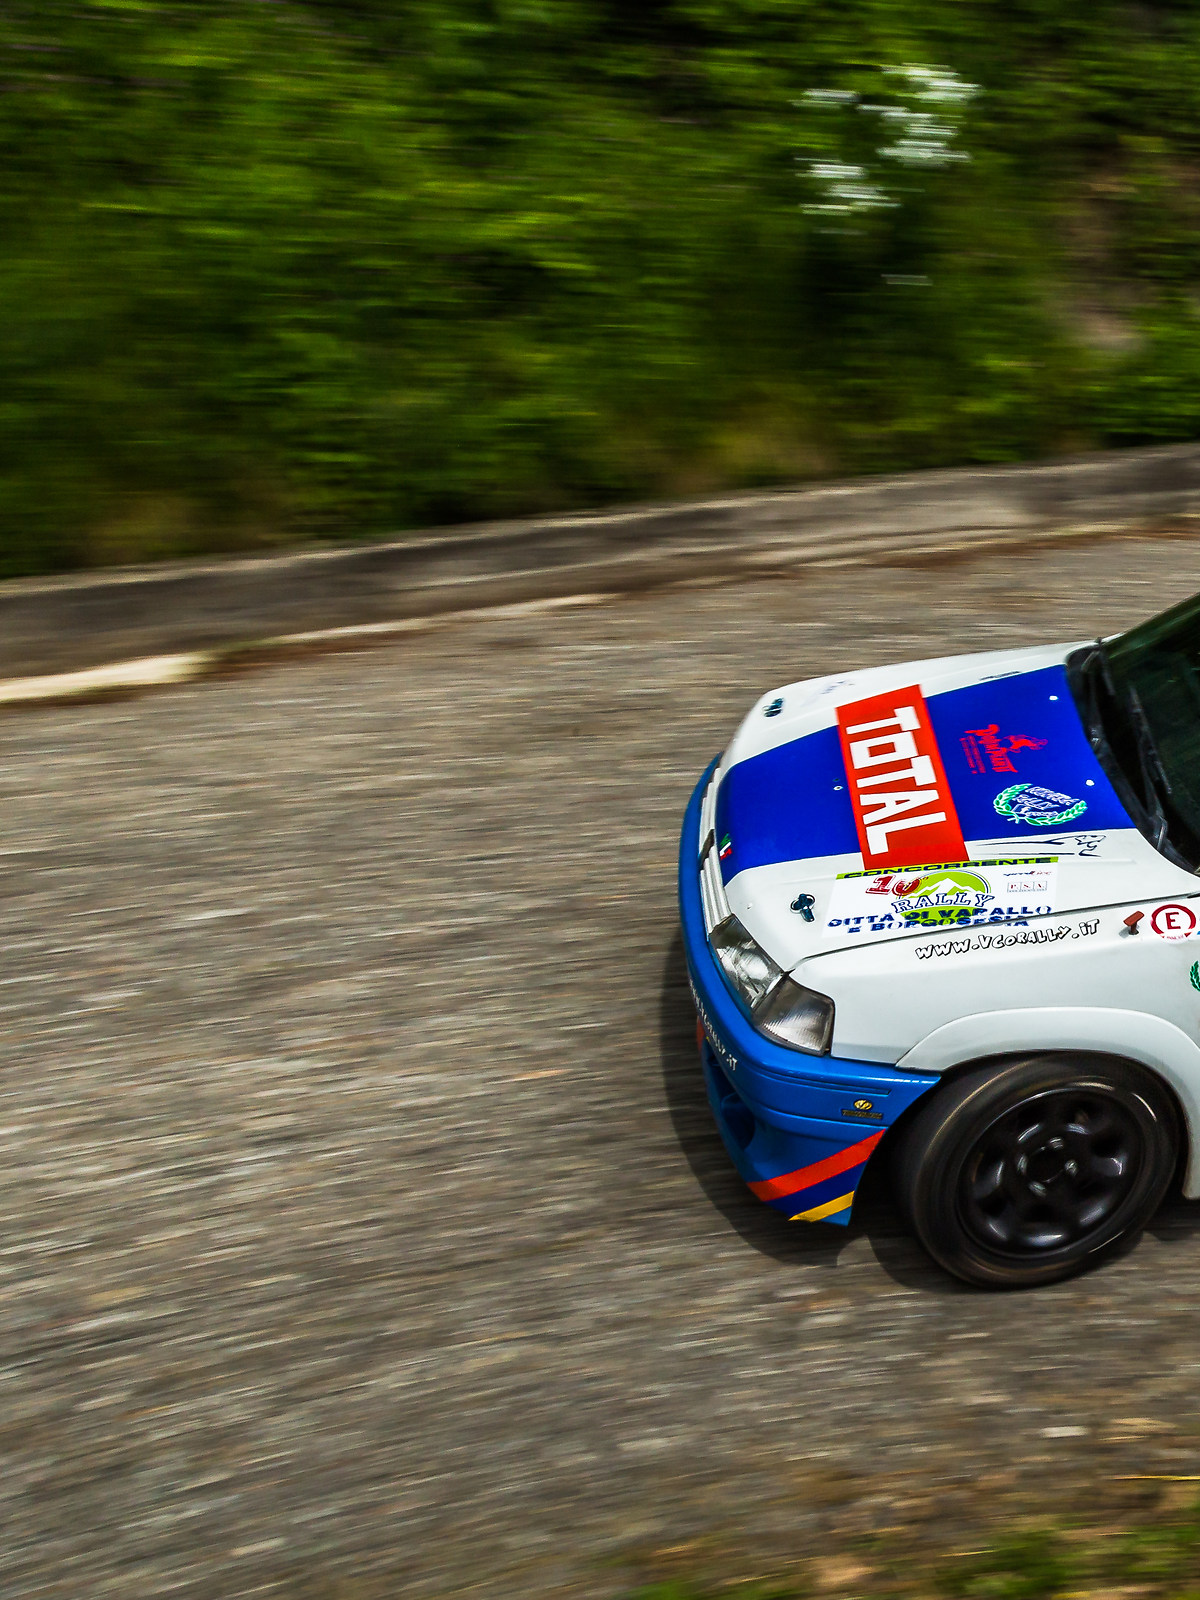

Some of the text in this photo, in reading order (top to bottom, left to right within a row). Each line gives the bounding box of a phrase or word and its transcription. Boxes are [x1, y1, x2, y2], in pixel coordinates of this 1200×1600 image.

[845, 705, 947, 855] TOTAL
[844, 857, 1051, 879] CONCORRENTE
[891, 893, 995, 913] RALLY
[1165, 911, 1182, 930] E
